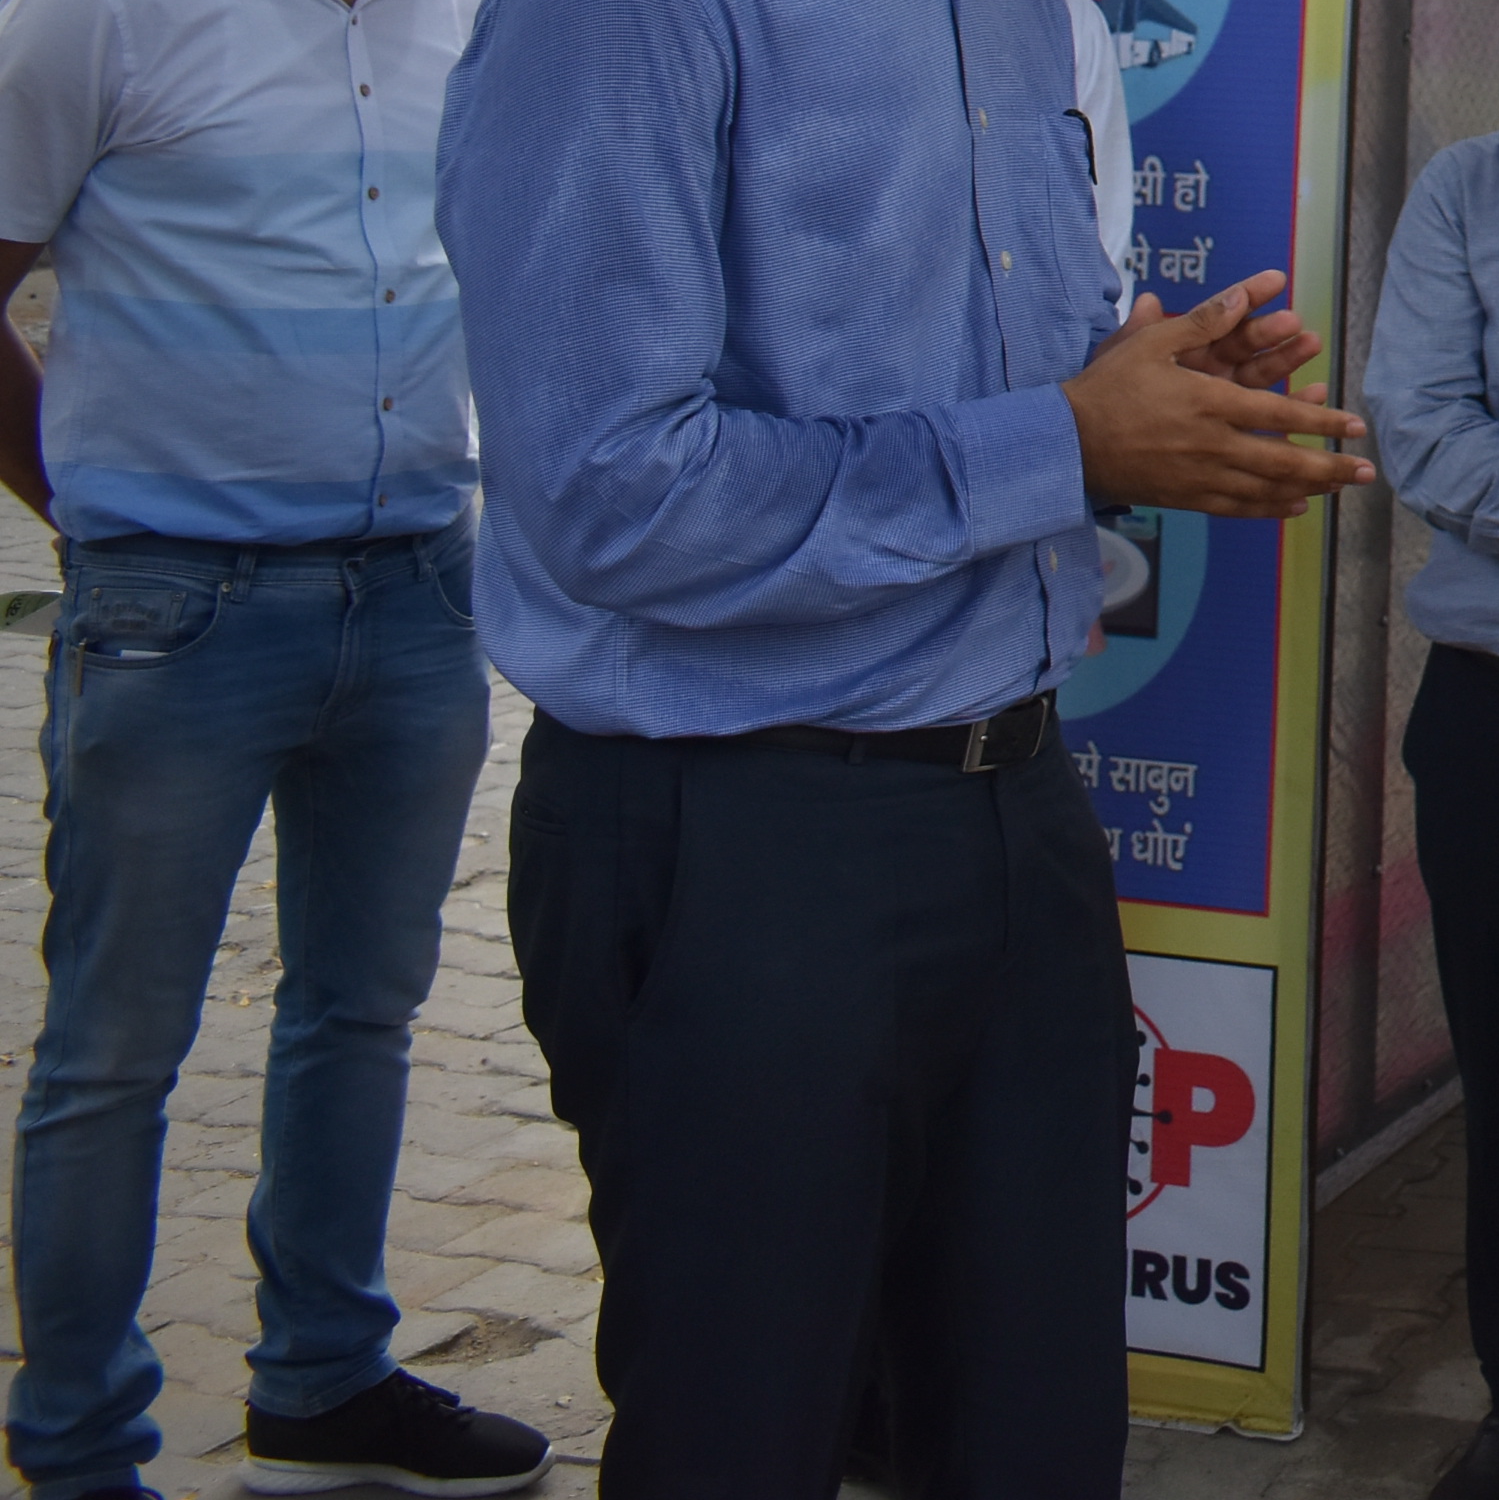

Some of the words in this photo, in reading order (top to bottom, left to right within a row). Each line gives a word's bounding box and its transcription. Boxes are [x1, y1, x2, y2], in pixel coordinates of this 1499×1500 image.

[1173, 159, 1211, 213] हो
[1158, 236, 1215, 285] बचें
[1108, 755, 1199, 816] साबुन
[1130, 817, 1194, 872] धोएं
